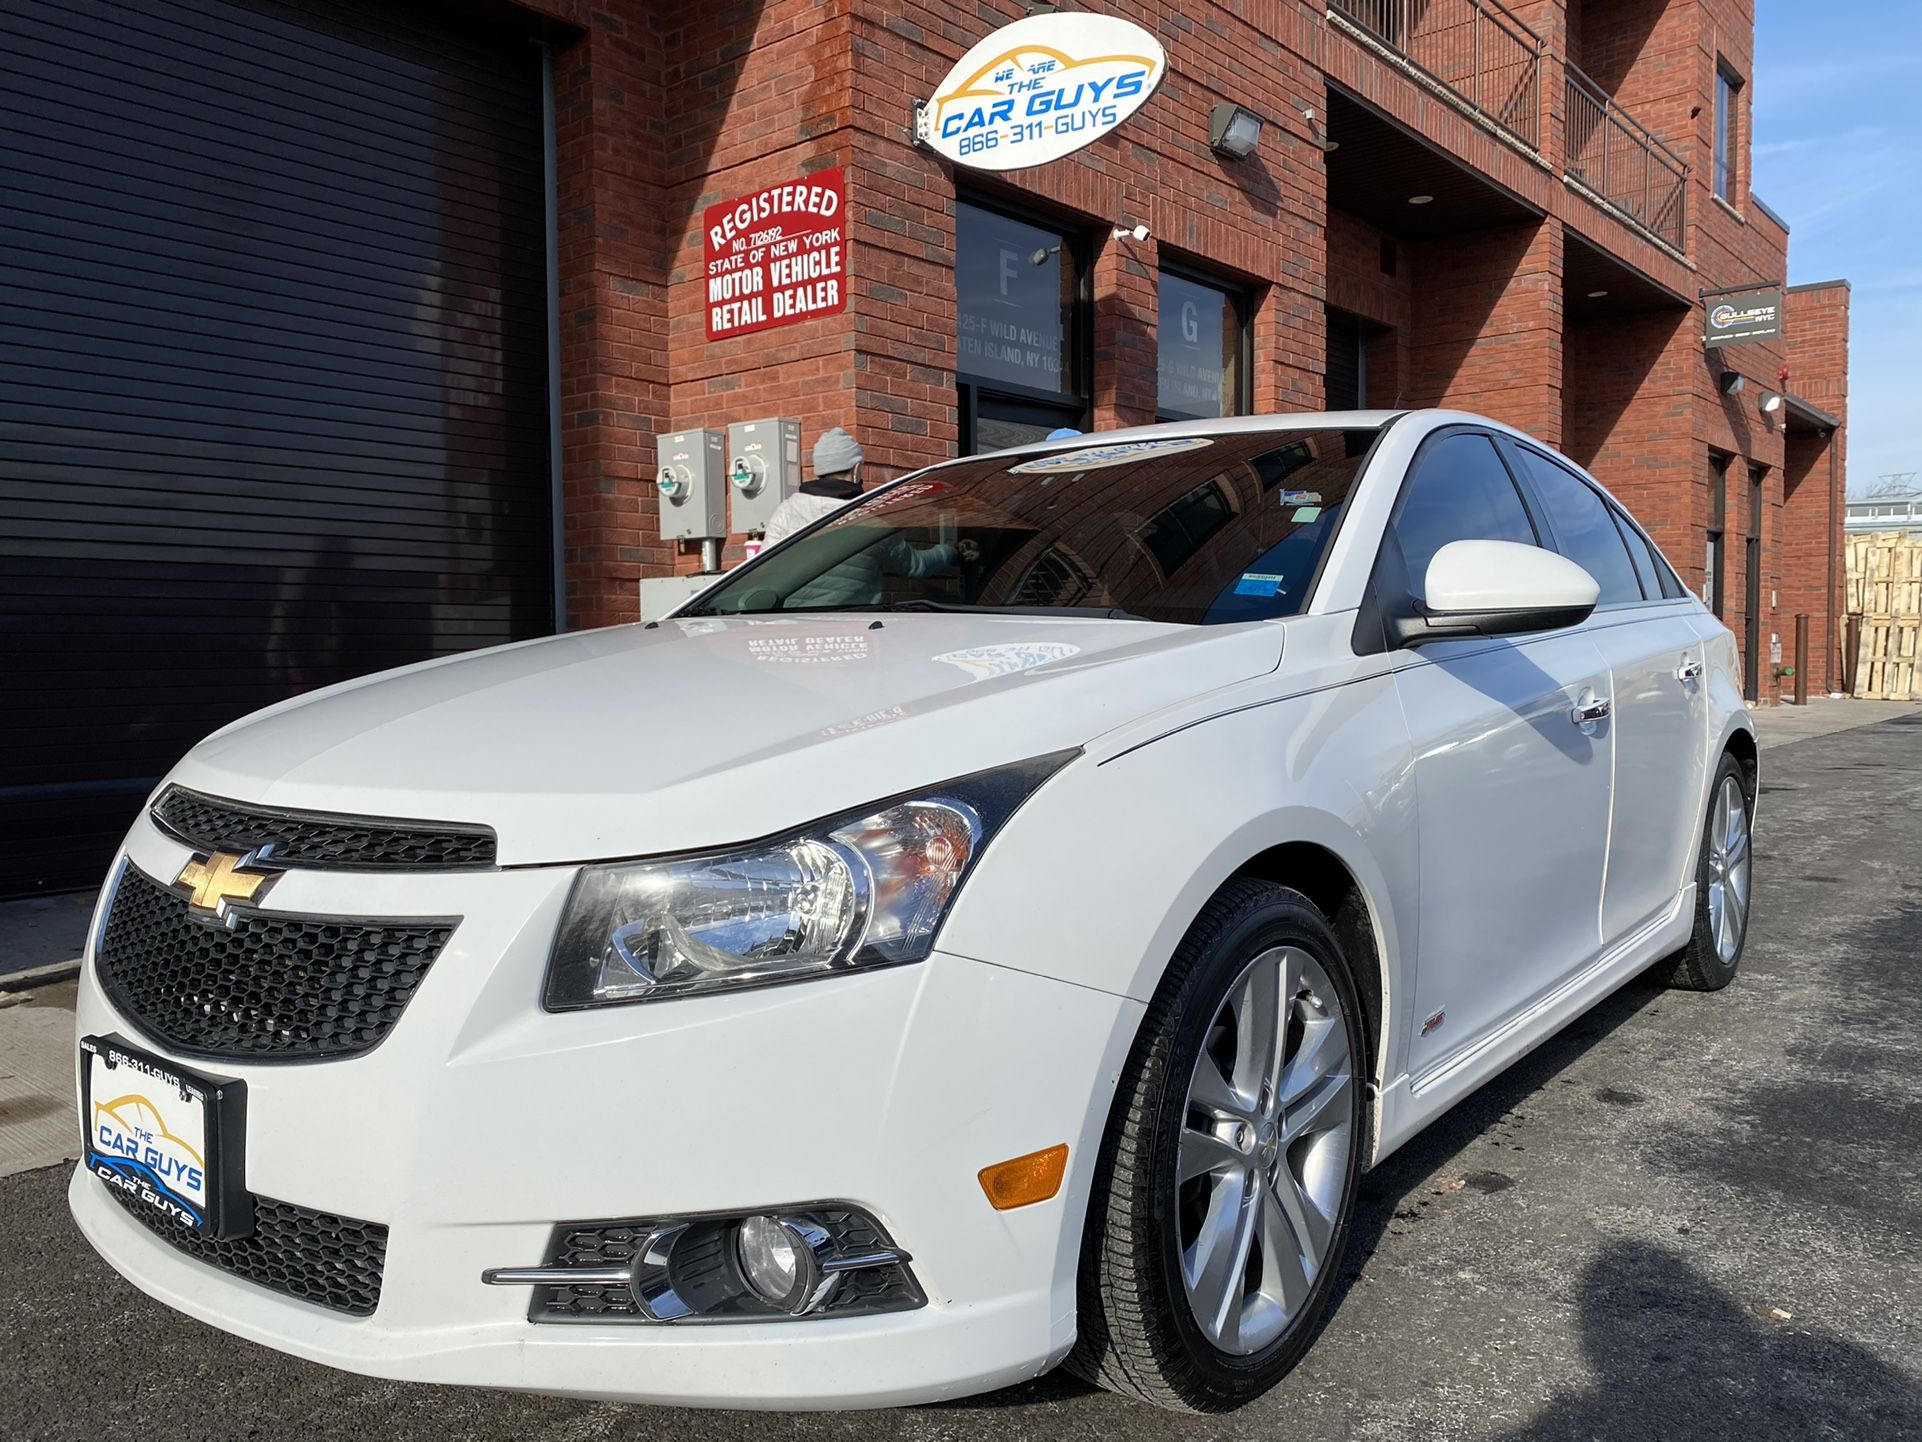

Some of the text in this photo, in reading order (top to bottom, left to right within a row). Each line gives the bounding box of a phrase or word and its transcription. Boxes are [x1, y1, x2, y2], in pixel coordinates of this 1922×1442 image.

[994, 60, 1056, 84] WE ARE
[1007, 77, 1046, 95] THE
[941, 70, 1146, 139] CAR GUYS
[958, 105, 1117, 156] 866-311-GUYS
[709, 185, 838, 251] REGISTERED
[709, 227, 840, 275] STATE OF NEW YORK
[732, 237, 747, 253] NO.
[709, 246, 841, 303] MOTOR VEHICLE
[1000, 248, 1018, 296] F
[712, 279, 839, 332] RETAIL DEALER
[1181, 301, 1198, 343] G
[990, 319, 1017, 341] WILD
[985, 342, 1024, 367] ISLAND,
[1026, 351, 1040, 367] NY
[108, 1050, 180, 1088] 866-311-GUYS
[99, 1125, 203, 1191] CAR GUYS
[134, 1126, 153, 1145] THE
[97, 1166, 195, 1227] CAR GUYS
[131, 1175, 151, 1190] THE
